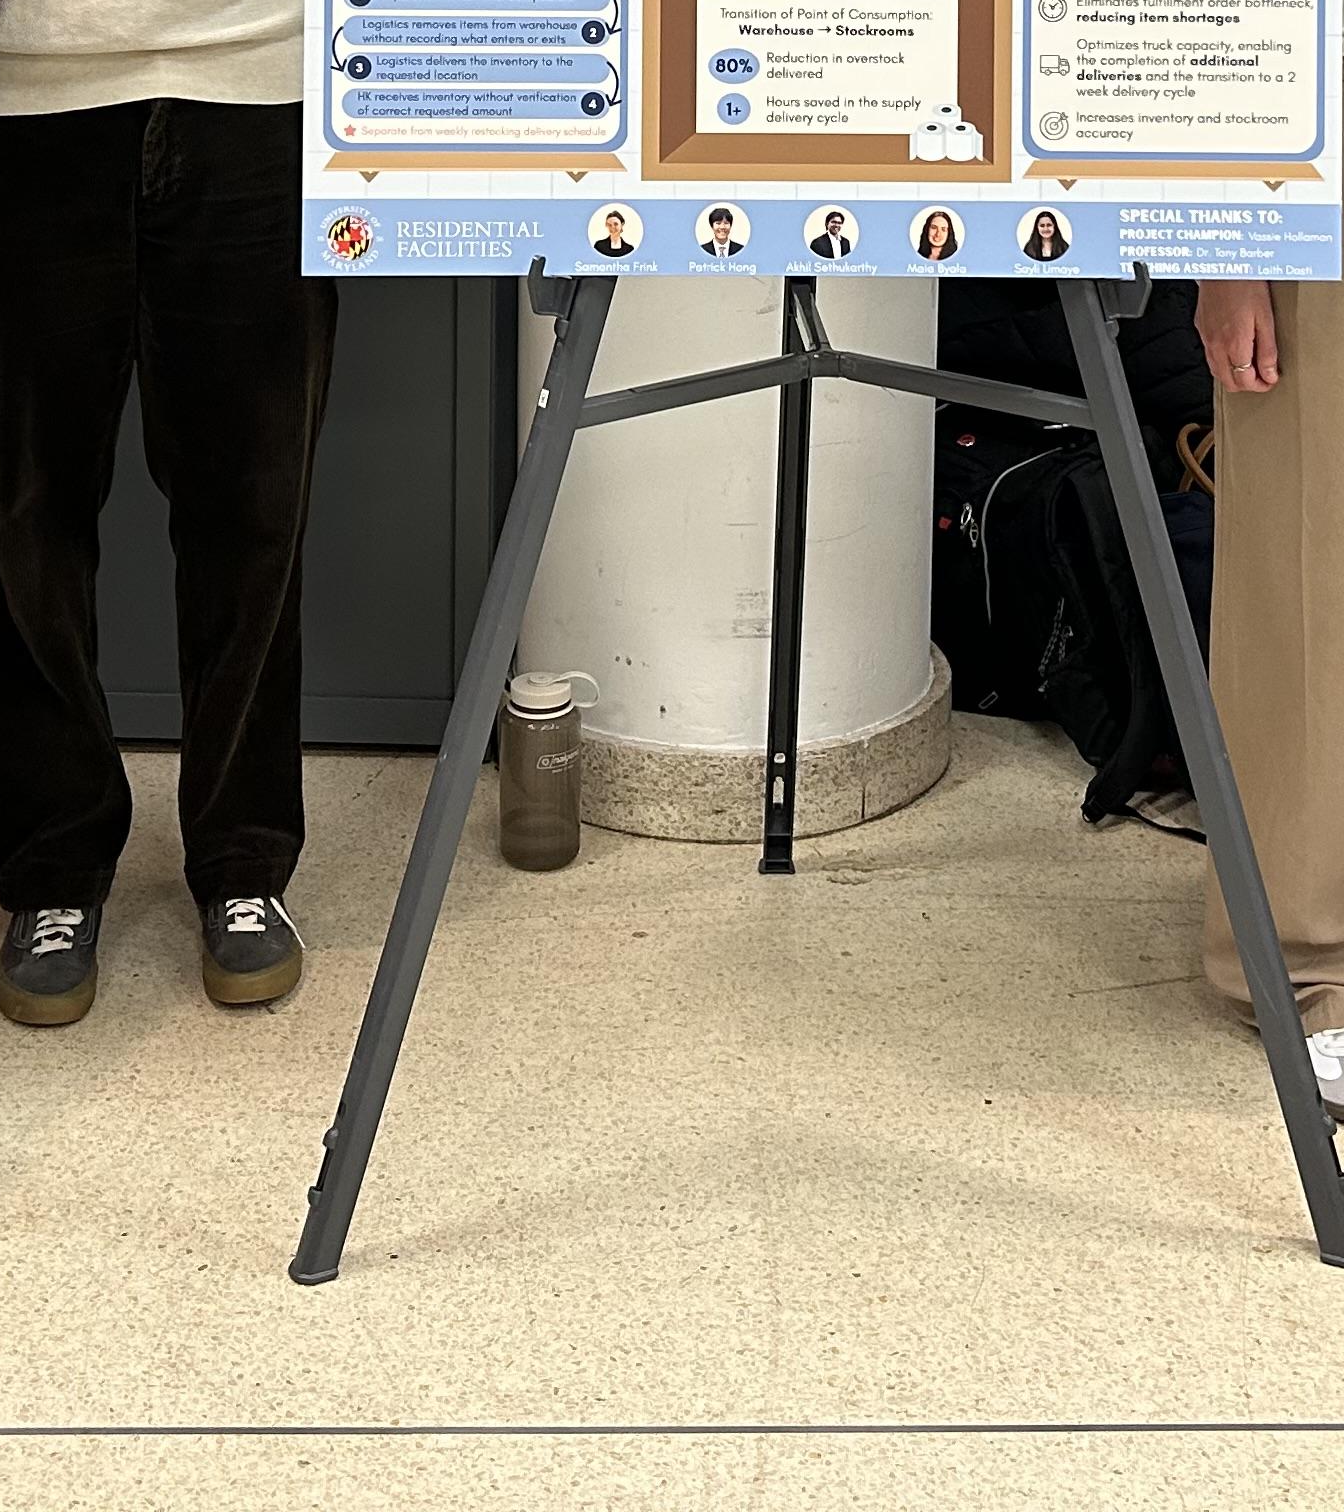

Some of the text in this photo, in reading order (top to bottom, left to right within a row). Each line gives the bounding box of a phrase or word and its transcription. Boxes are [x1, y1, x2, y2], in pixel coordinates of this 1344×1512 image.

[720, 7, 776, 18] Transition
[780, 7, 793, 19] of
[797, 8, 828, 19] Point
[831, 8, 845, 19] of
[1076, 11, 1240, 26] reducing item shortages
[362, 19, 408, 31] Logistics
[460, 20, 488, 28] items
[491, 18, 516, 29] from
[518, 19, 577, 29] warehouse
[589, 27, 596, 37] 2
[738, 23, 914, 36] Warehouse Stockrooms
[1076, 38, 1291, 54] Optimizes truck capacity, enabling
[766, 51, 904, 63] Reduction in overstock
[715, 58, 752, 72] 80%
[766, 66, 822, 78] delivered
[726, 102, 741, 115] 1+
[1076, 112, 1288, 126] Increases inventory and stockroom
[1119, 208, 1282, 224] SPECIAL THANKS TO:
[396, 220, 544, 238] RESIDENTIAL
[1119, 228, 1173, 239] PROJECT
[1176, 229, 1244, 240] CHAMPION:
[397, 240, 512, 258] FACILITIES
[1119, 245, 1192, 256] PROFESSOR:
[1239, 247, 1274, 257] Barber
[320, 249, 380, 272] MARYLAND
[574, 261, 629, 272] Samantha
